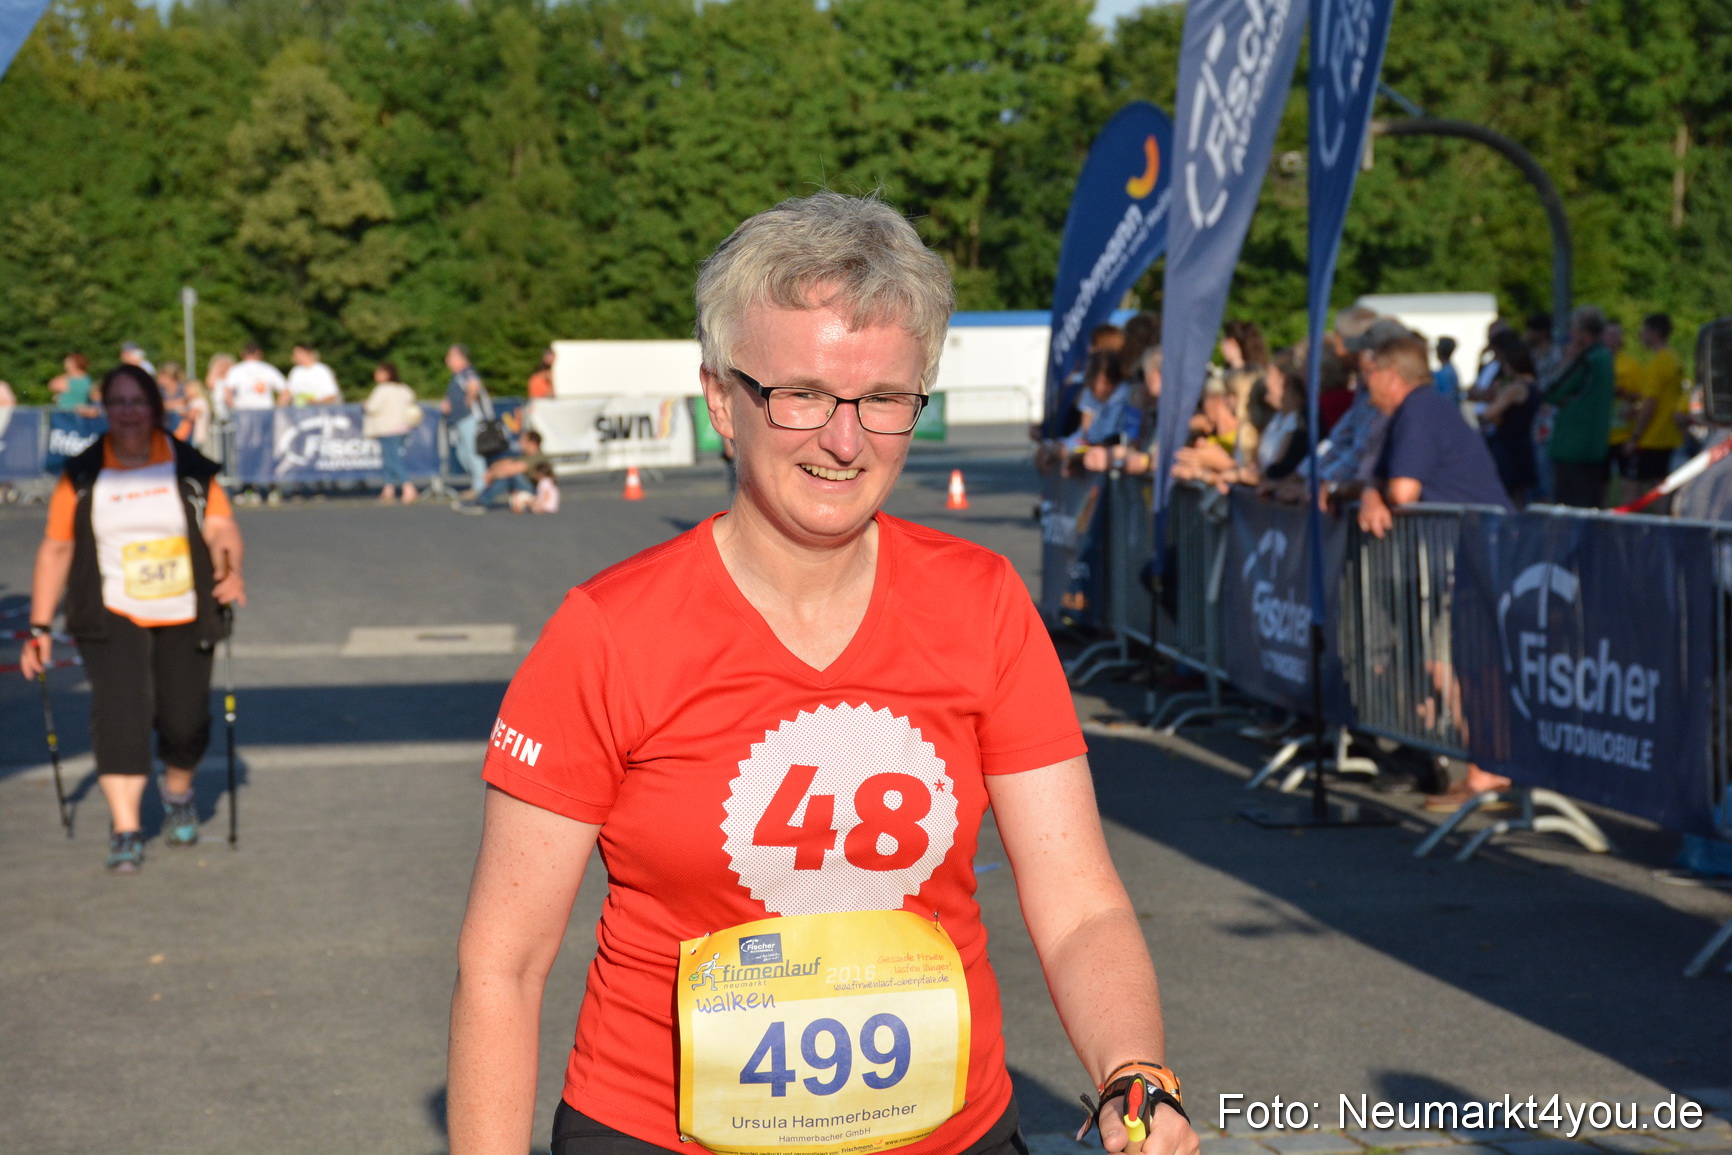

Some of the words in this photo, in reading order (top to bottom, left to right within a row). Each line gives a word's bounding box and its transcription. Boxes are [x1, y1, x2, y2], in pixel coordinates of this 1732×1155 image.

[1252, 579, 1313, 648] Fische
[1519, 631, 1661, 723] Fischer
[746, 942, 776, 951] Fischer
[722, 956, 822, 982] firmenlauf
[825, 964, 877, 984] 2016
[723, 980, 767, 989] neumarkt
[696, 991, 776, 1014] walken
[739, 1012, 912, 1098] 499
[732, 1116, 788, 1129] Ursula
[792, 1104, 917, 1128] Hammerbacher
[778, 1131, 843, 1143] Hammerbacher
[845, 1127, 871, 1138] GmbH
[841, 1144, 874, 1154] Frischmann
